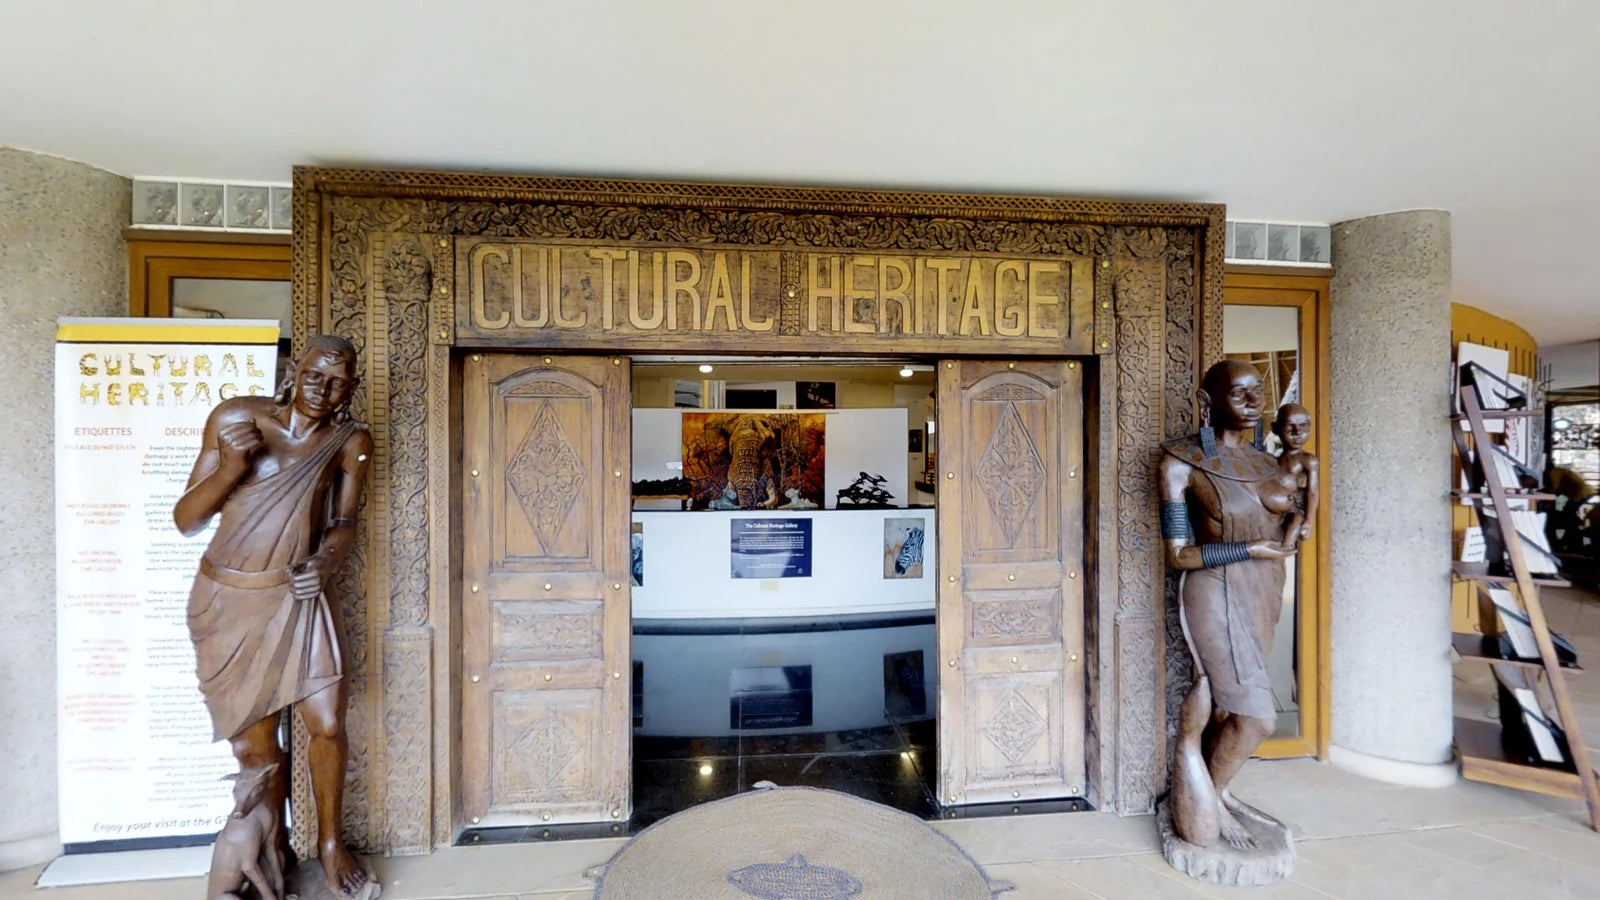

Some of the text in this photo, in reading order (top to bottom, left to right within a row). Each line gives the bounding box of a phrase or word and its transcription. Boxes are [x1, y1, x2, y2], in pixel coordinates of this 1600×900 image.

[472, 246, 1064, 337] CULTURAL HERITAGE
[79, 353, 265, 377] CULTURAL
[74, 427, 132, 436] ETIQUETTES
[93, 822, 122, 832] Enjoy
[126, 822, 151, 832] your
[155, 818, 177, 828] visit
[180, 818, 191, 827] at
[193, 815, 211, 826] the
